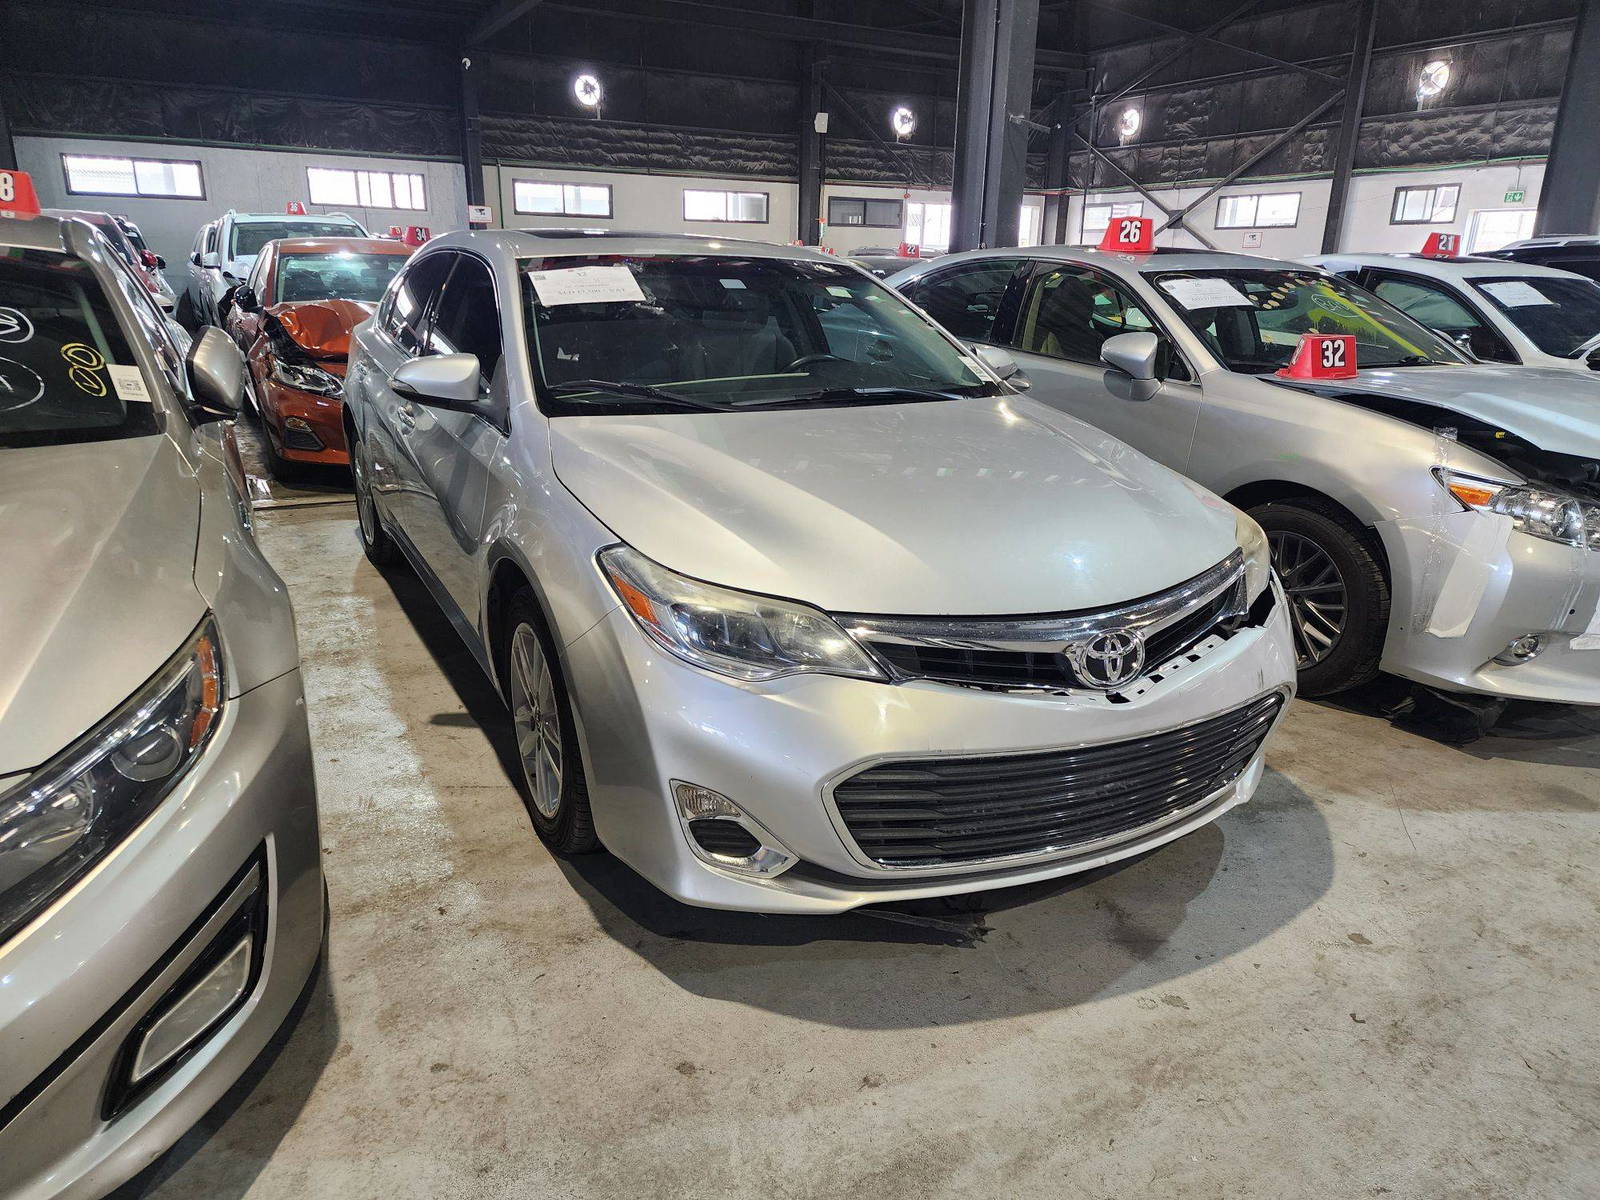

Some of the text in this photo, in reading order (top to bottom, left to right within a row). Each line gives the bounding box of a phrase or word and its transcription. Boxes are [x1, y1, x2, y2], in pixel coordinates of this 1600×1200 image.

[1119, 220, 1142, 243] 26
[1438, 234, 1454, 251] 21
[1321, 339, 1346, 368] 32
